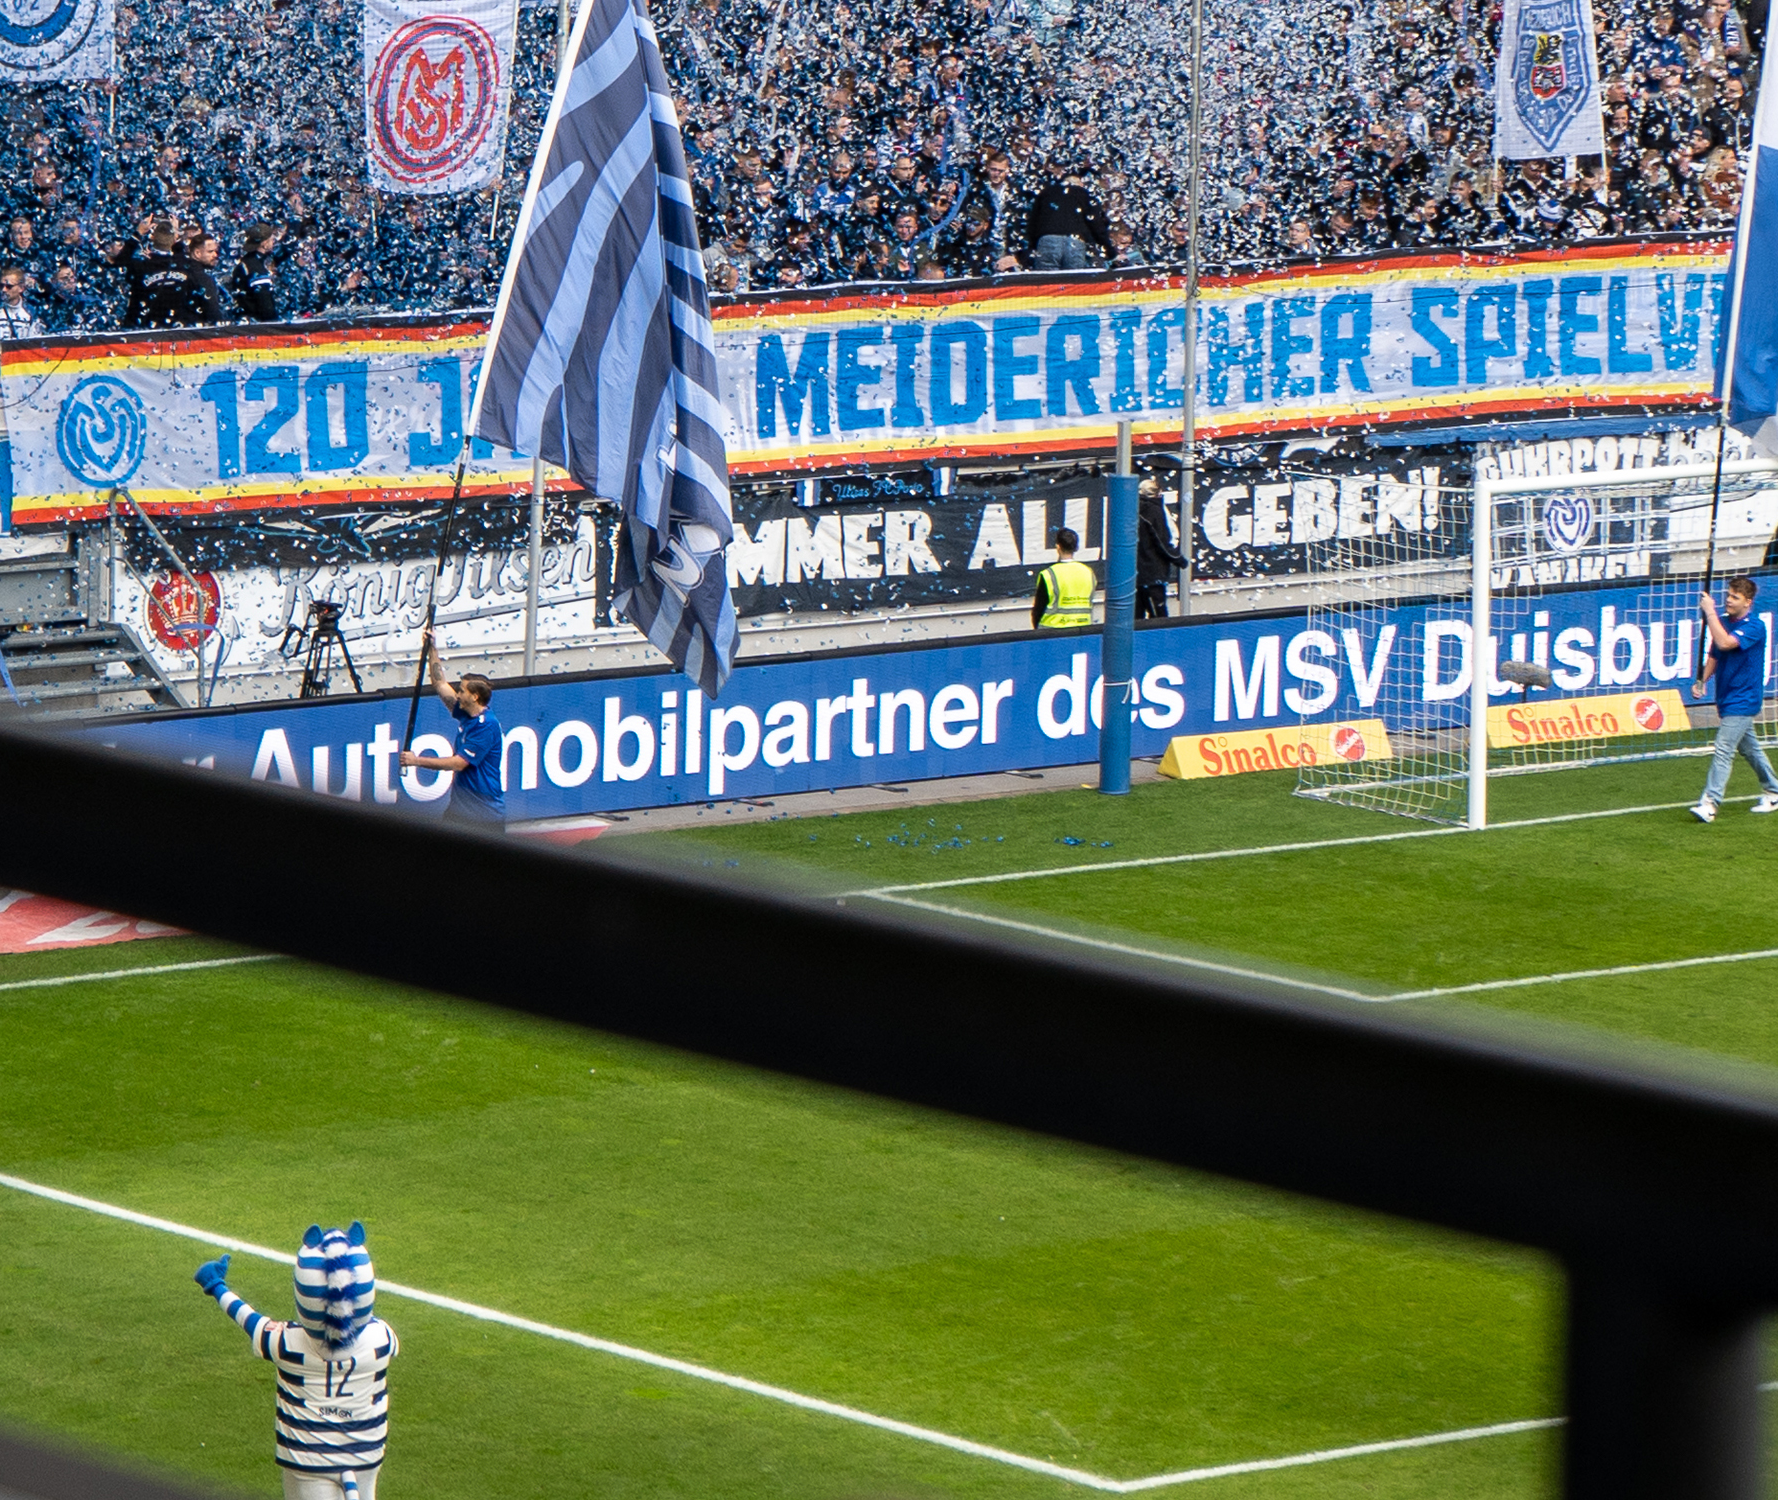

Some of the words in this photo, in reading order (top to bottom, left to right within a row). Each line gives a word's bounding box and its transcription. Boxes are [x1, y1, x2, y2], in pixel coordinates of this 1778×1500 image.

[202, 360, 371, 479] 120
[756, 291, 1372, 440] MEIDERICHER
[1412, 268, 1738, 387] SPIELV
[728, 508, 943, 590] MMER
[968, 494, 1180, 571] ALL
[1202, 466, 1441, 552] GEBEN!
[430, 534, 598, 604] ilsen
[1490, 550, 1651, 590] ANAKEN
[1215, 621, 1396, 724] MSV
[1423, 604, 1773, 705] Duisbu
[1507, 702, 1620, 742] Sinalco
[1198, 729, 1317, 777] Sinalco
[323, 1355, 355, 1398] 12
[318, 1406, 353, 1419] SIMON
